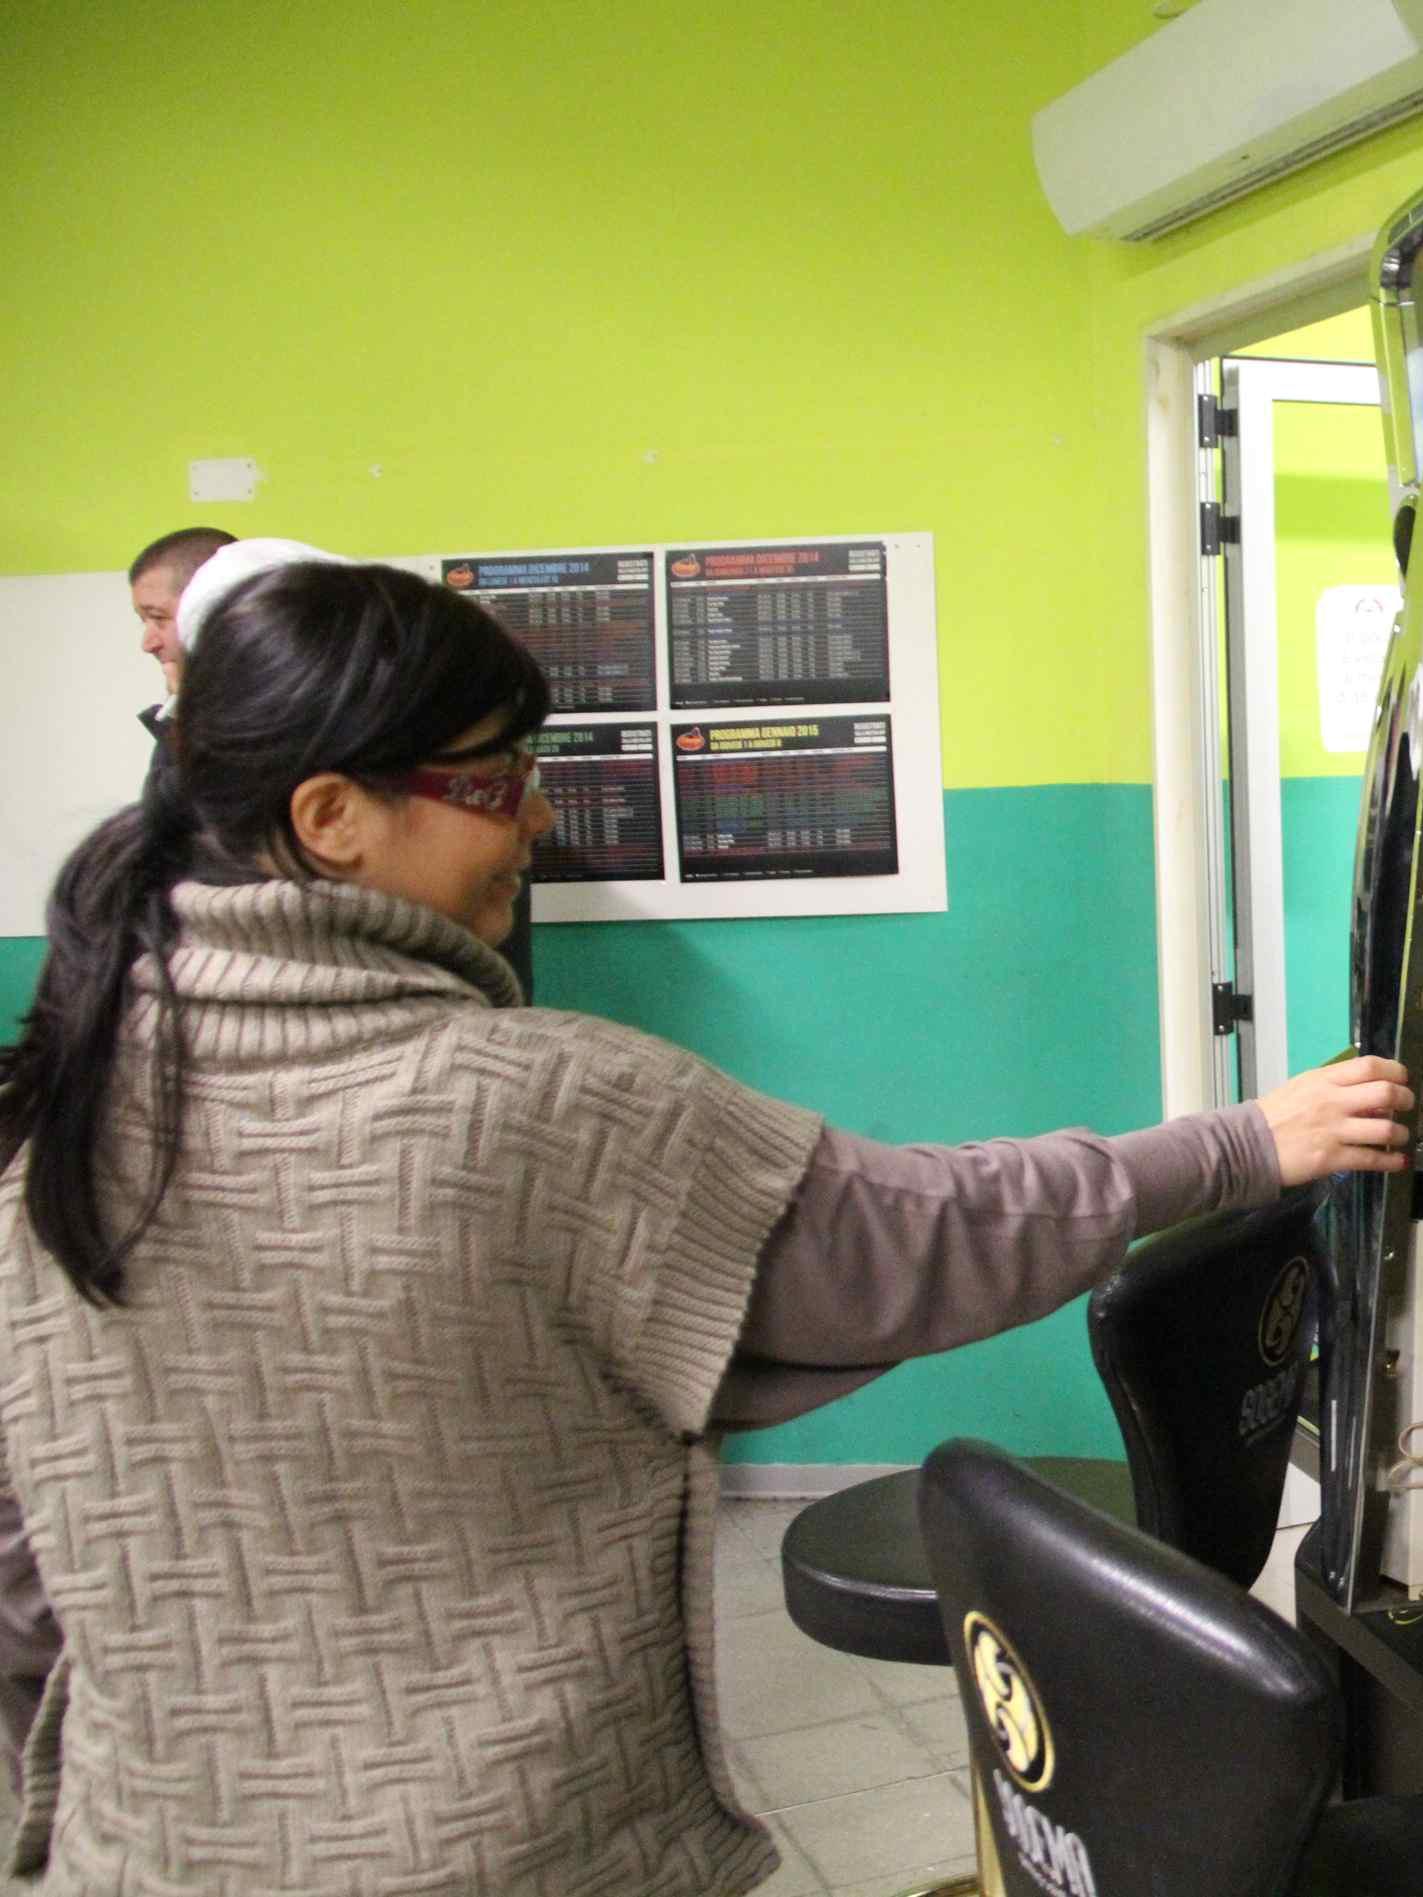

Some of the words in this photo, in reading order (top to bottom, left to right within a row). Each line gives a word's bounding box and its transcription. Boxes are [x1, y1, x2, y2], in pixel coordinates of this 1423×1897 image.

[568, 561, 590, 573] 2014
[574, 731, 594, 743] 2014
[709, 728, 759, 740] PROGRAMMA
[797, 724, 819, 736] 2015
